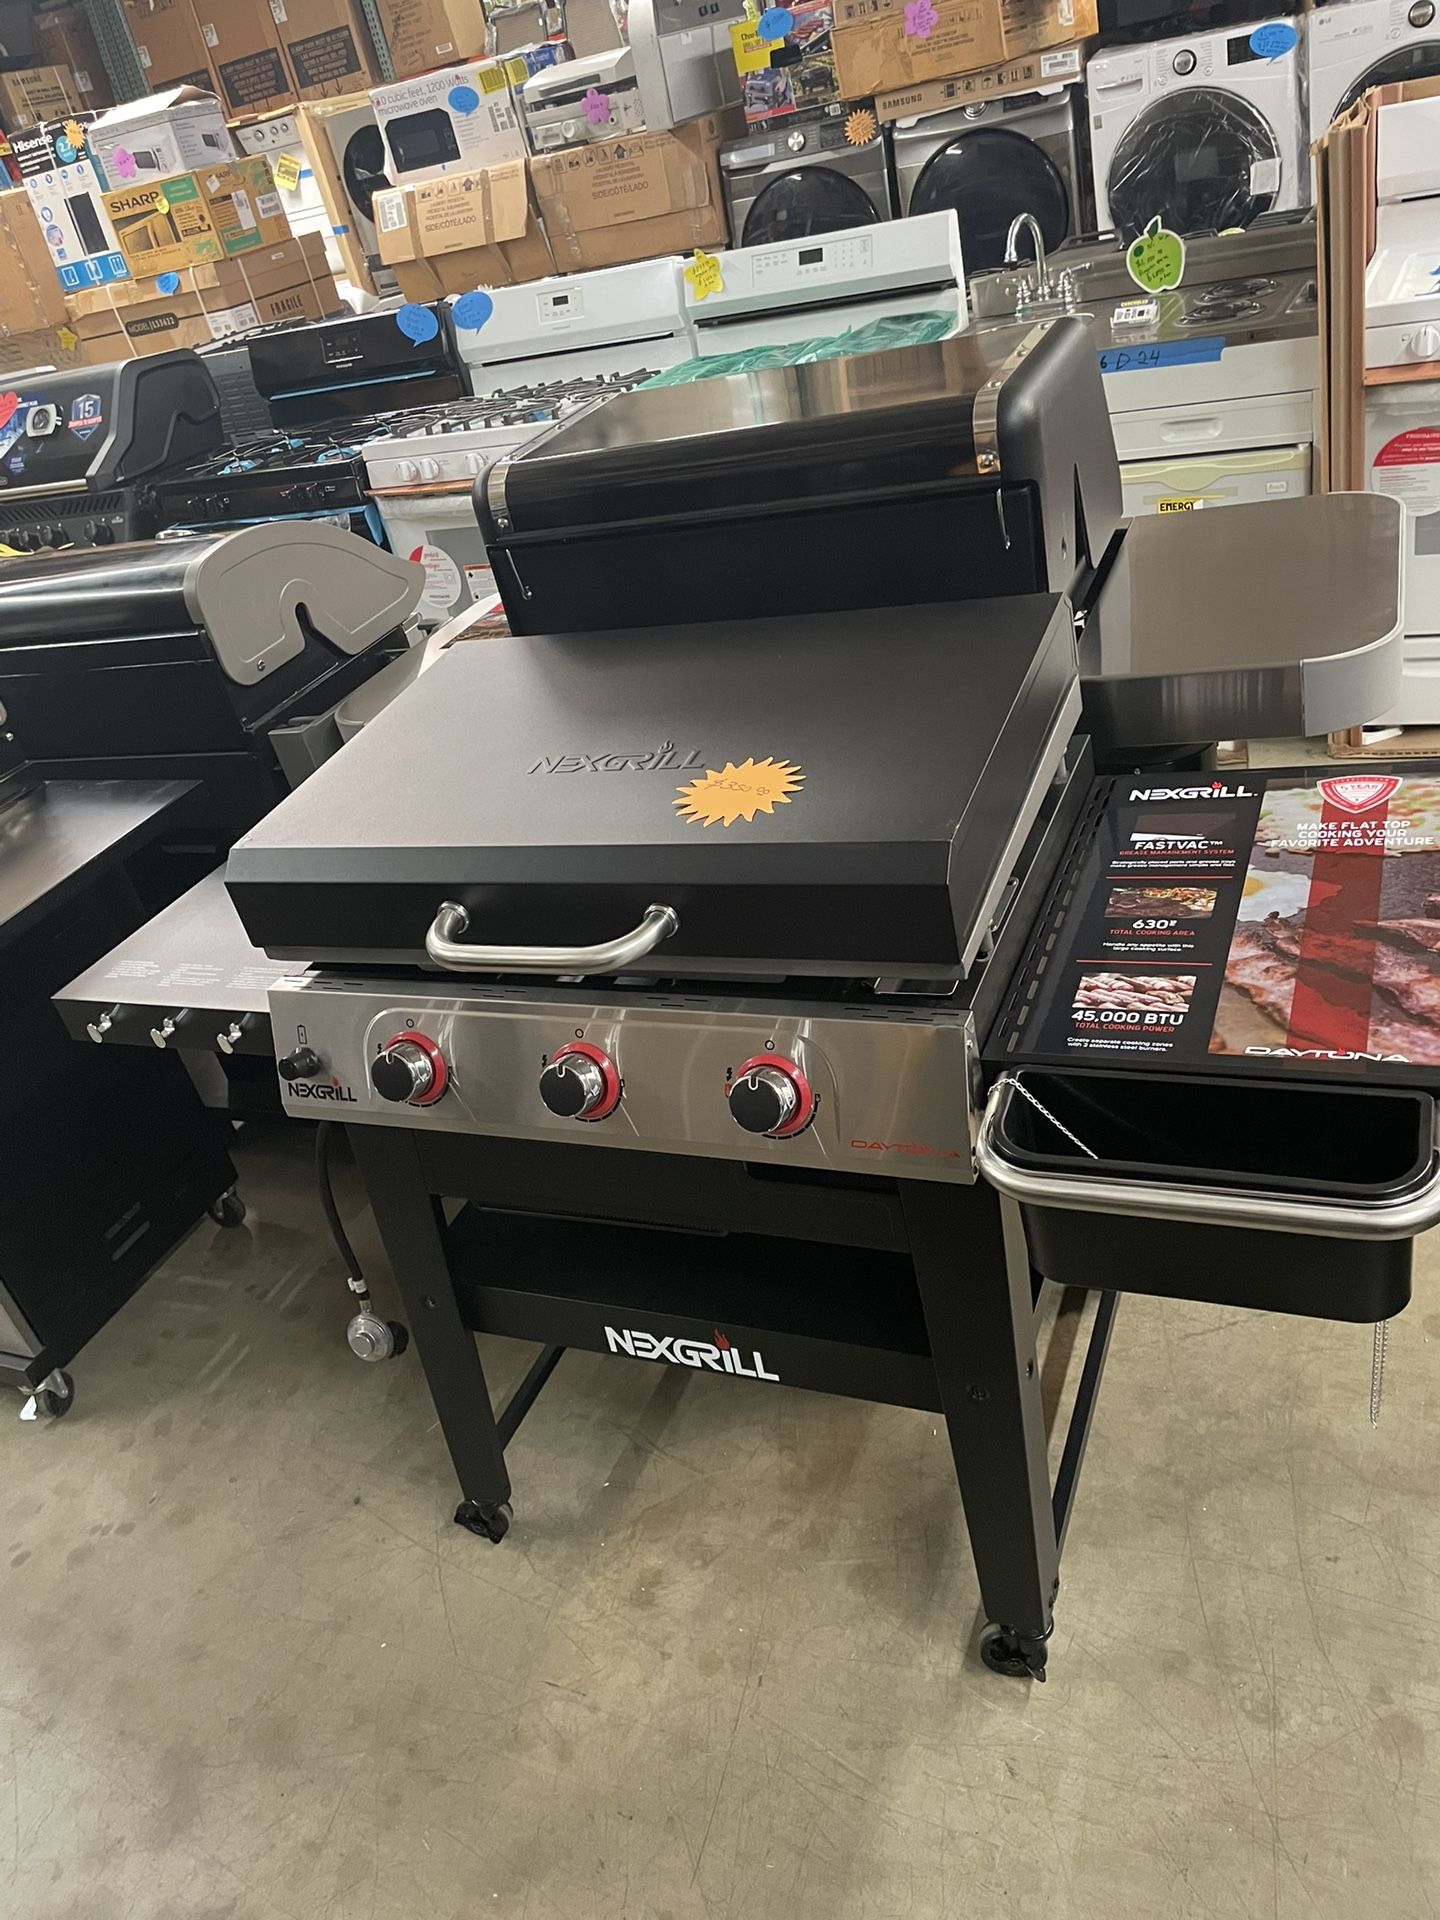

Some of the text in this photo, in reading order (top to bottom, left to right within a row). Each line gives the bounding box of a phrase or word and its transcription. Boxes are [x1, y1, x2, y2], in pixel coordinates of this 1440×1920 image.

[427, 80, 446, 93] 1200
[882, 93, 922, 110] SAMSUNG
[13, 135, 53, 153] Hisense
[110, 191, 160, 213] SHARP
[270, 294, 303, 316] FRAGILE
[78, 401, 94, 419] 15
[527, 748, 706, 775] NEXGRILL
[1297, 820, 1411, 831] MAKE FLAT TOP
[1298, 829, 1407, 839] COOKING YOUR
[1271, 836, 1435, 848] FAVORITE ADVENTURE
[1071, 1010, 1184, 1026] 45,000 BTU
[1102, 1023, 1141, 1031] COOKING
[288, 1082, 358, 1102] NEXGRILL
[604, 1326, 780, 1382] NEXGRILL
